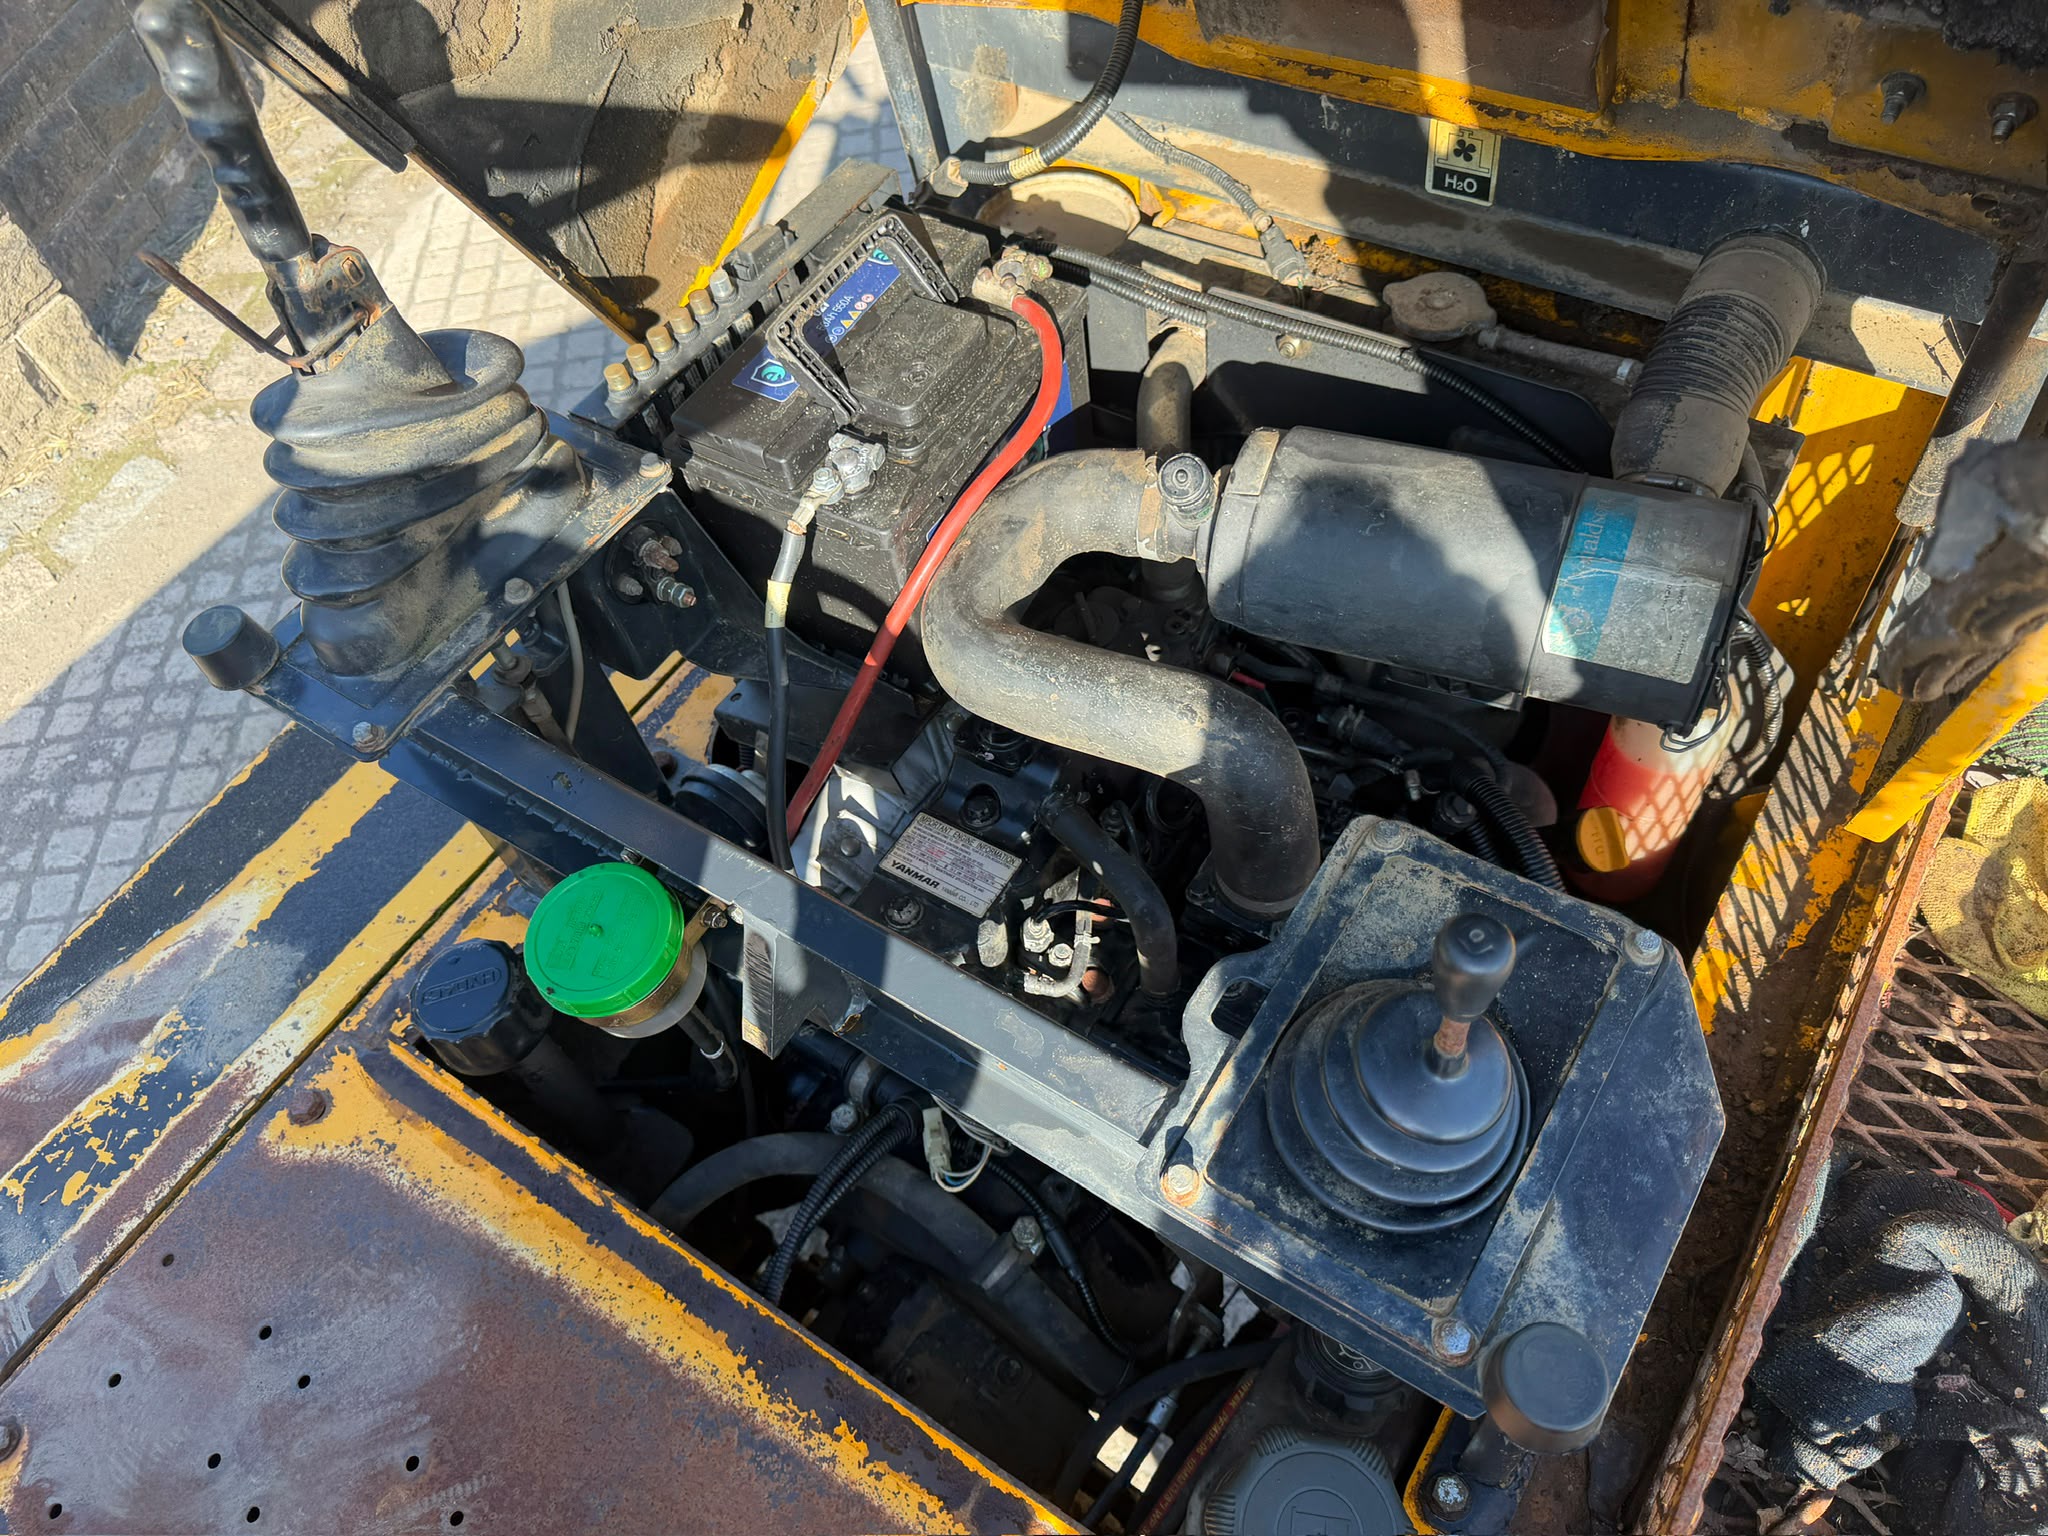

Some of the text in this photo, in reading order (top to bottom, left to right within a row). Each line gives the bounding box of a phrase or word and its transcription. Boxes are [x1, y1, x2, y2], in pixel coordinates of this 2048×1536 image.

[1444, 173, 1478, 193] H2O
[918, 815, 1017, 865] IMPORTANT ENGINE INFORMATION
[891, 859, 940, 889] YANMAR
